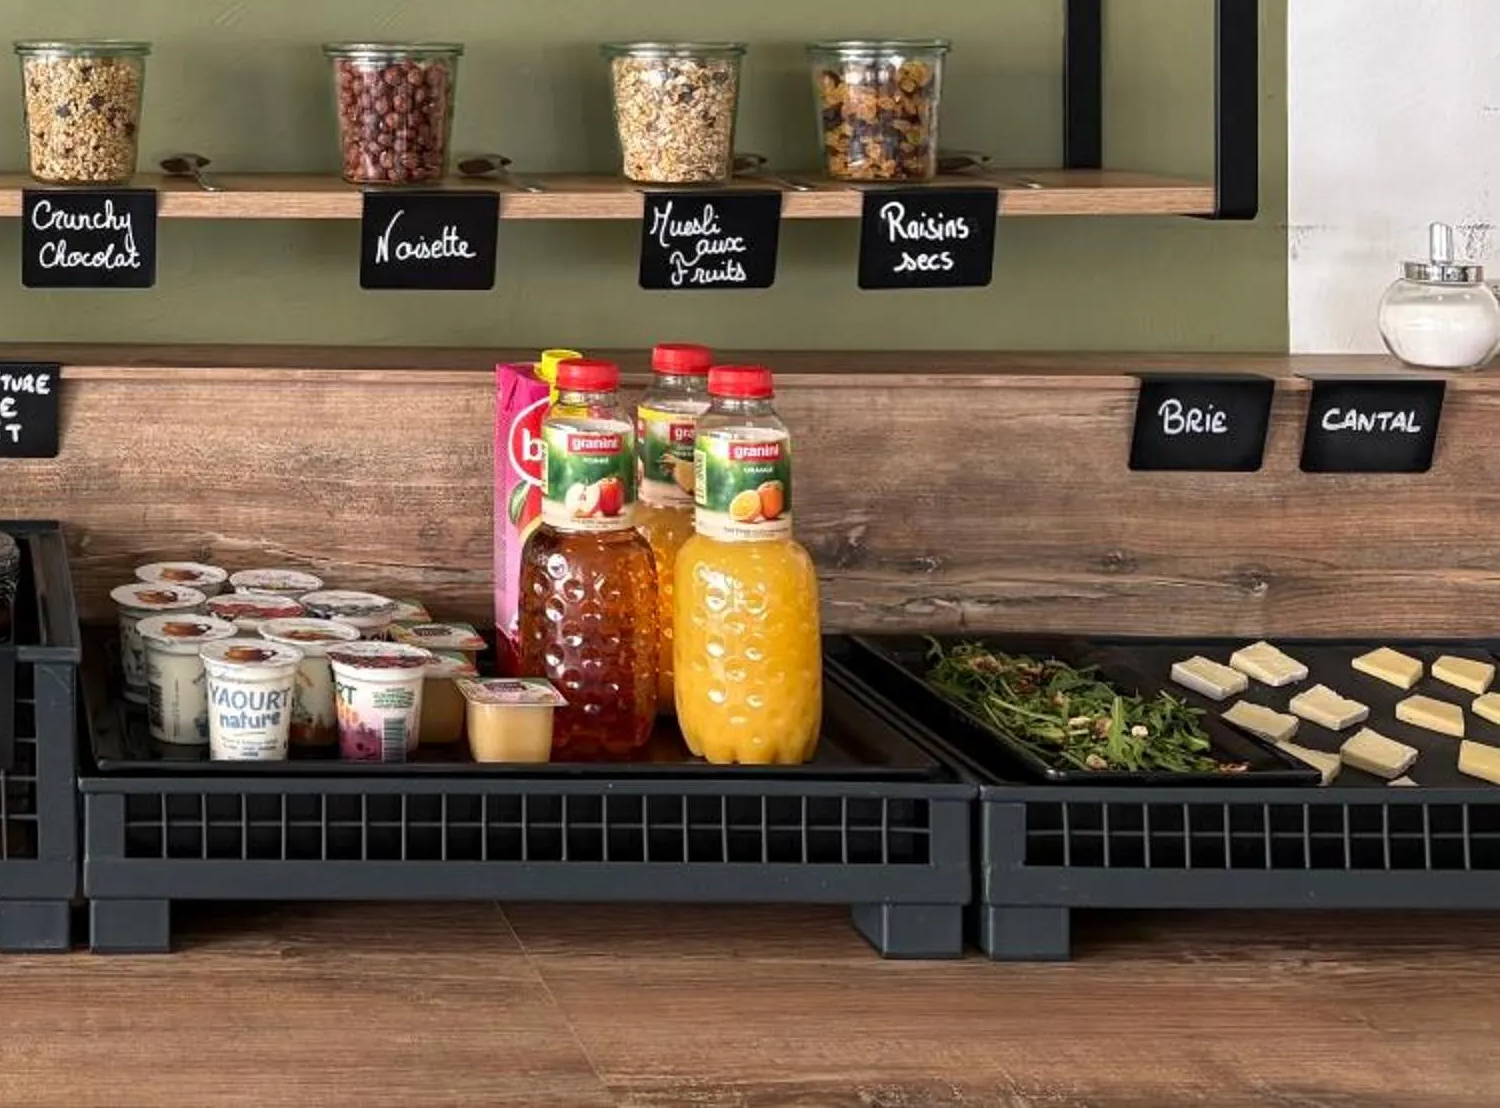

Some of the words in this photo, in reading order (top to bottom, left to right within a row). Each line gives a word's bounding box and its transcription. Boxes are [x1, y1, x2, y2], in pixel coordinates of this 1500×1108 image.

[31, 199, 136, 252] Crunchy
[649, 200, 721, 248] Muesli
[880, 201, 970, 242] Raisins
[375, 209, 477, 265] Noisette
[695, 237, 747, 256] aux
[39, 239, 141, 269] Chocolat
[669, 251, 747, 286] Fruits
[893, 251, 954, 272] secs
[1321, 407, 1422, 434] CANTAL
[733, 443, 780, 459] granini
[209, 682, 291, 711] YAOURT
[220, 711, 282, 729] nature
